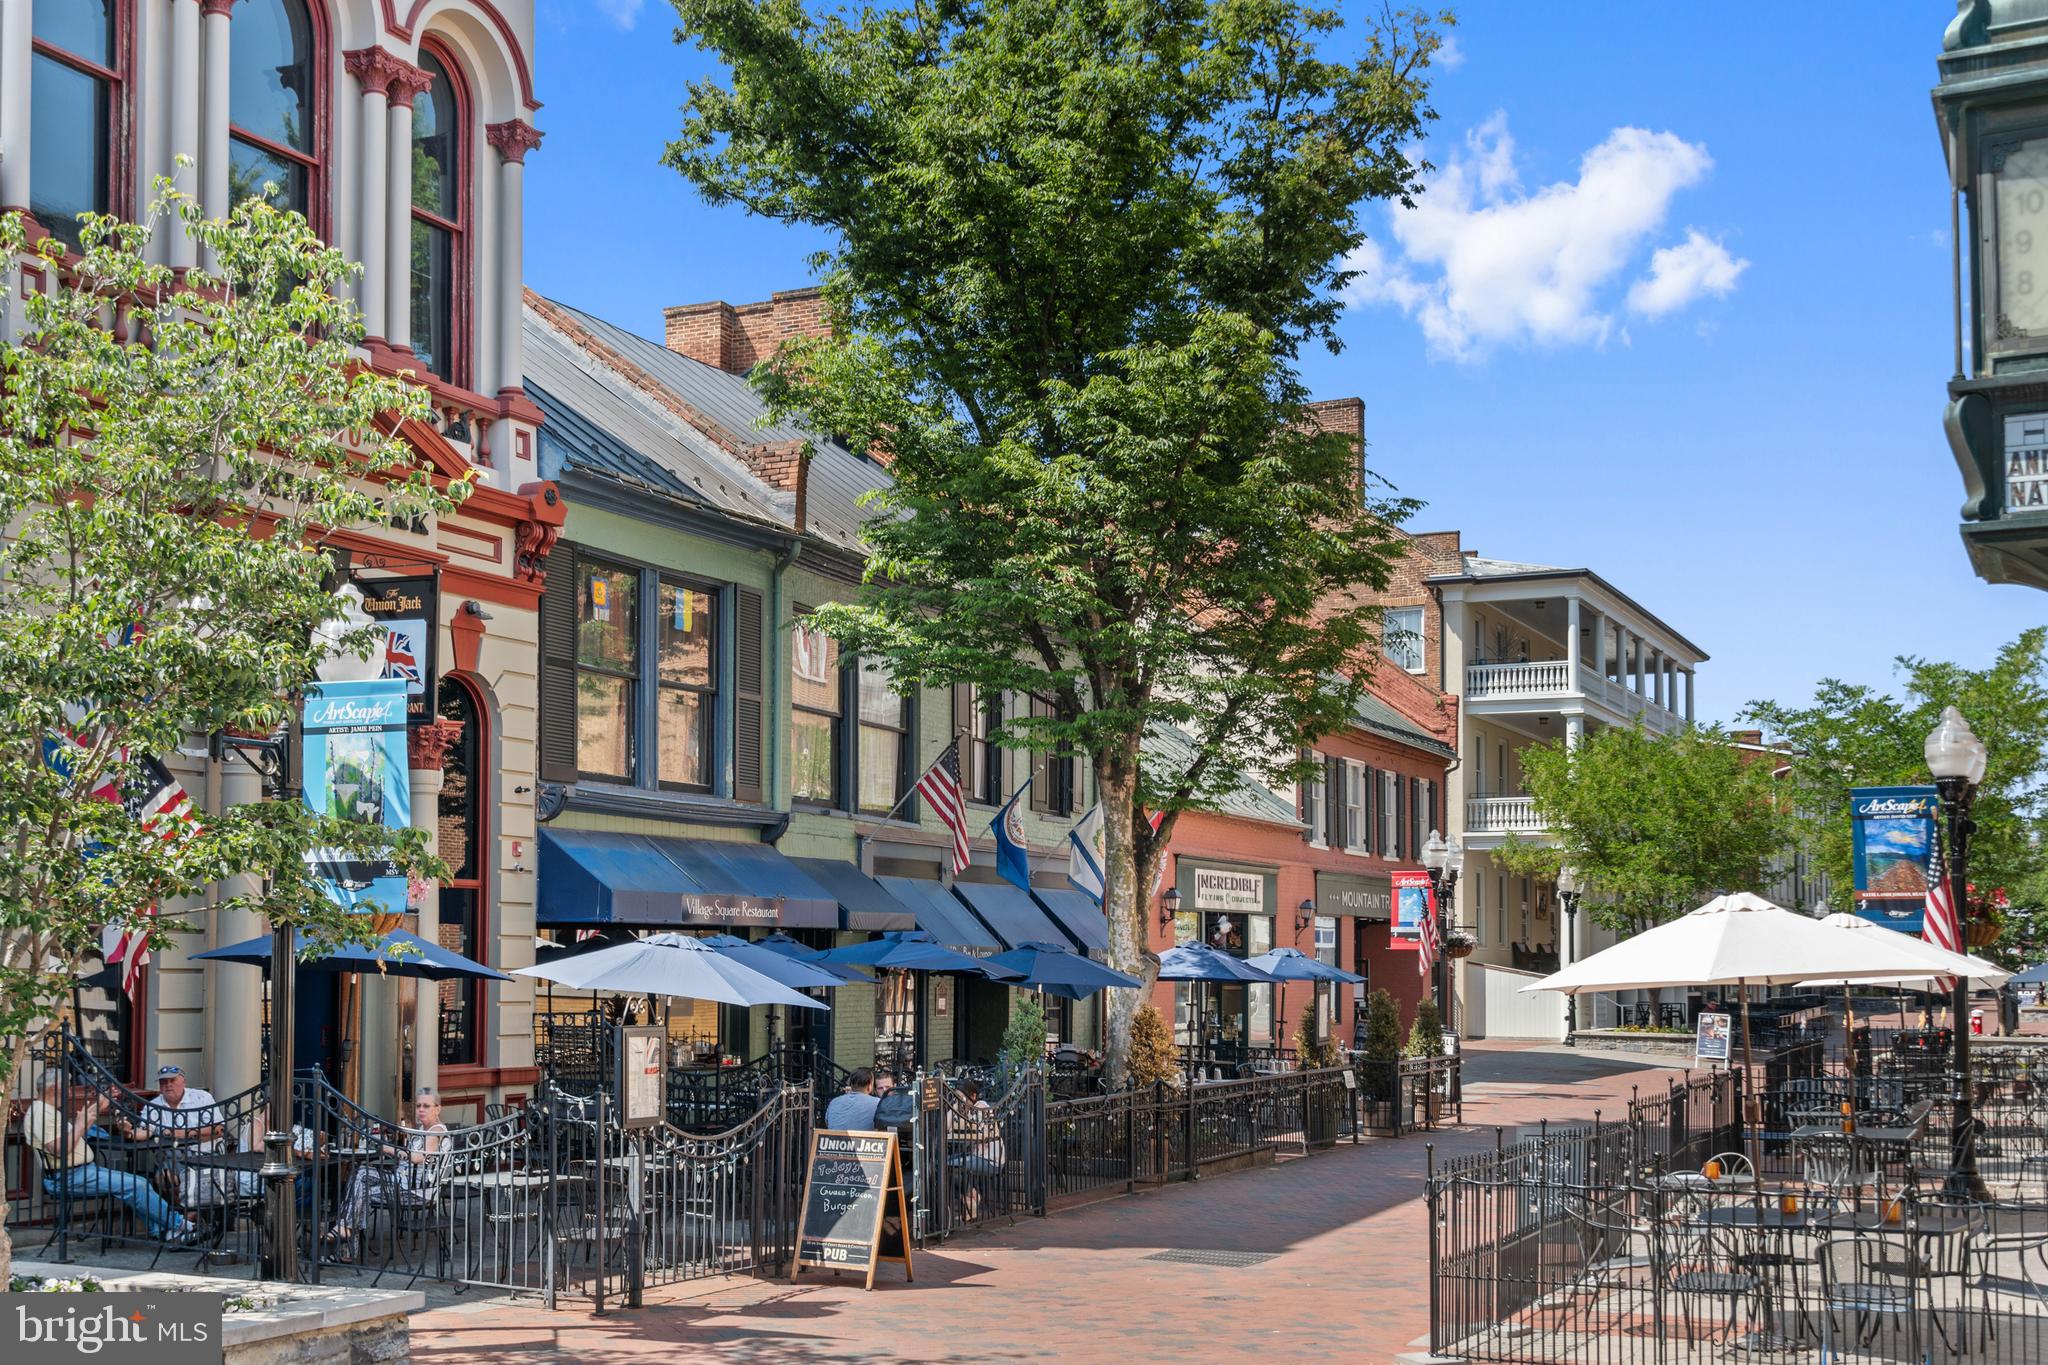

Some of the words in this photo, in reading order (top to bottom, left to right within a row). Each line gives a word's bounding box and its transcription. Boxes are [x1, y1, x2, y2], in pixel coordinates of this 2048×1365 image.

[2015, 229, 2033, 254] 9
[2016, 270, 2034, 296] 8
[365, 598, 397, 612] Union
[397, 595, 421, 612] Jack
[1197, 873, 1261, 904] INCREDIBLE
[1201, 893, 1220, 902] FLYING
[686, 898, 714, 920] Village
[714, 899, 741, 920] Square
[742, 900, 779, 919] Restaurant
[1341, 890, 1380, 909] MOUNTAIN
[823, 1198, 859, 1215] Burger
[823, 1247, 848, 1261] PUB
